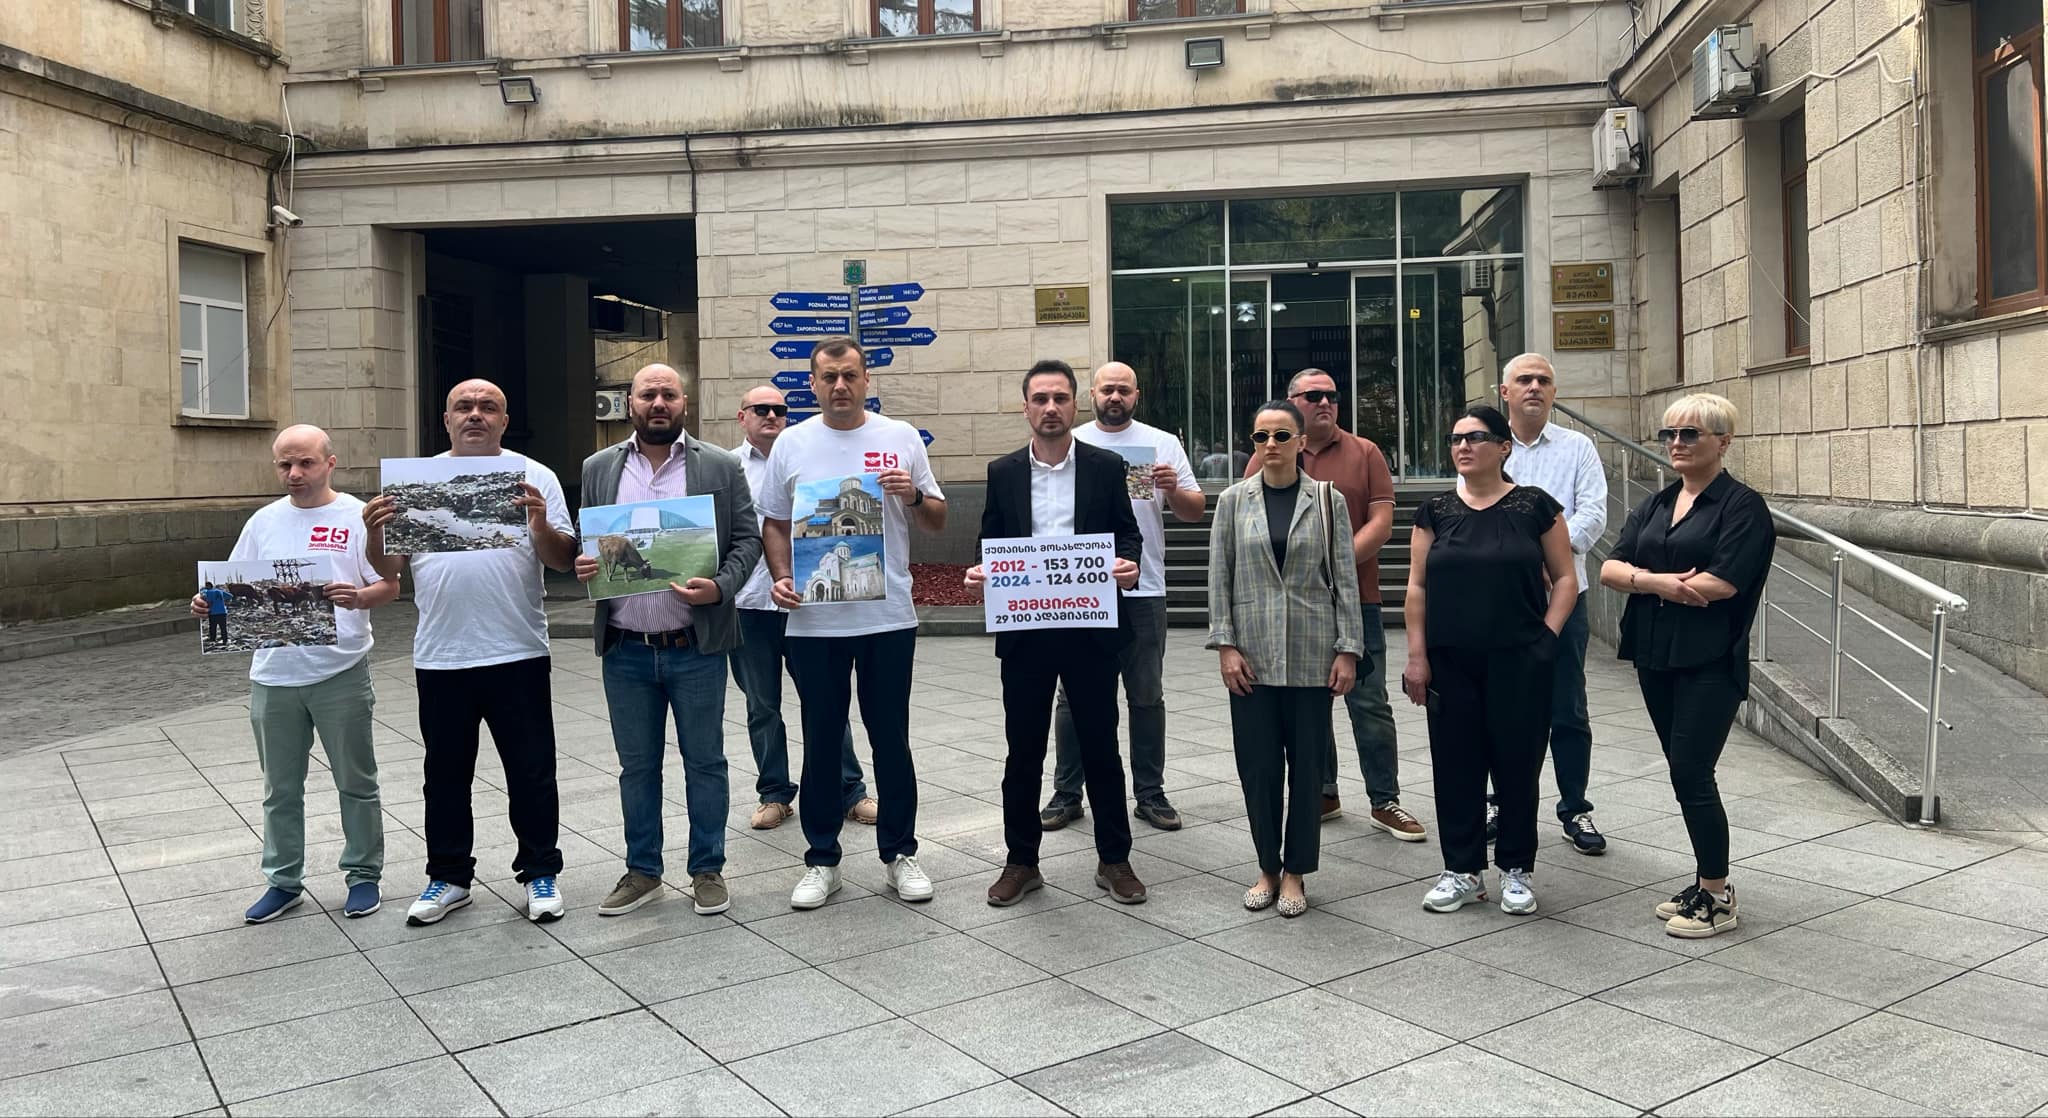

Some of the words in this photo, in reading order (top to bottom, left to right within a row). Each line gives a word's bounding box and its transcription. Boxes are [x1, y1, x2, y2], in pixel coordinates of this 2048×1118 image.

[885, 453, 896, 468] 5
[332, 528, 346, 543] 5
[985, 545, 1036, 554] ქუთაისის
[1040, 542, 1112, 552] მოსახლეობა
[991, 560, 1025, 573] 2012
[1044, 558, 1068, 570] 153
[1075, 556, 1104, 569] 700
[992, 575, 1030, 587] 2024
[1047, 574, 1072, 585] 124
[1077, 572, 1108, 584] 600
[1008, 597, 1100, 611] შემცირდა
[996, 615, 1008, 624] 29
[1013, 614, 1031, 623] 100
[1035, 611, 1108, 621] ადამიანით
